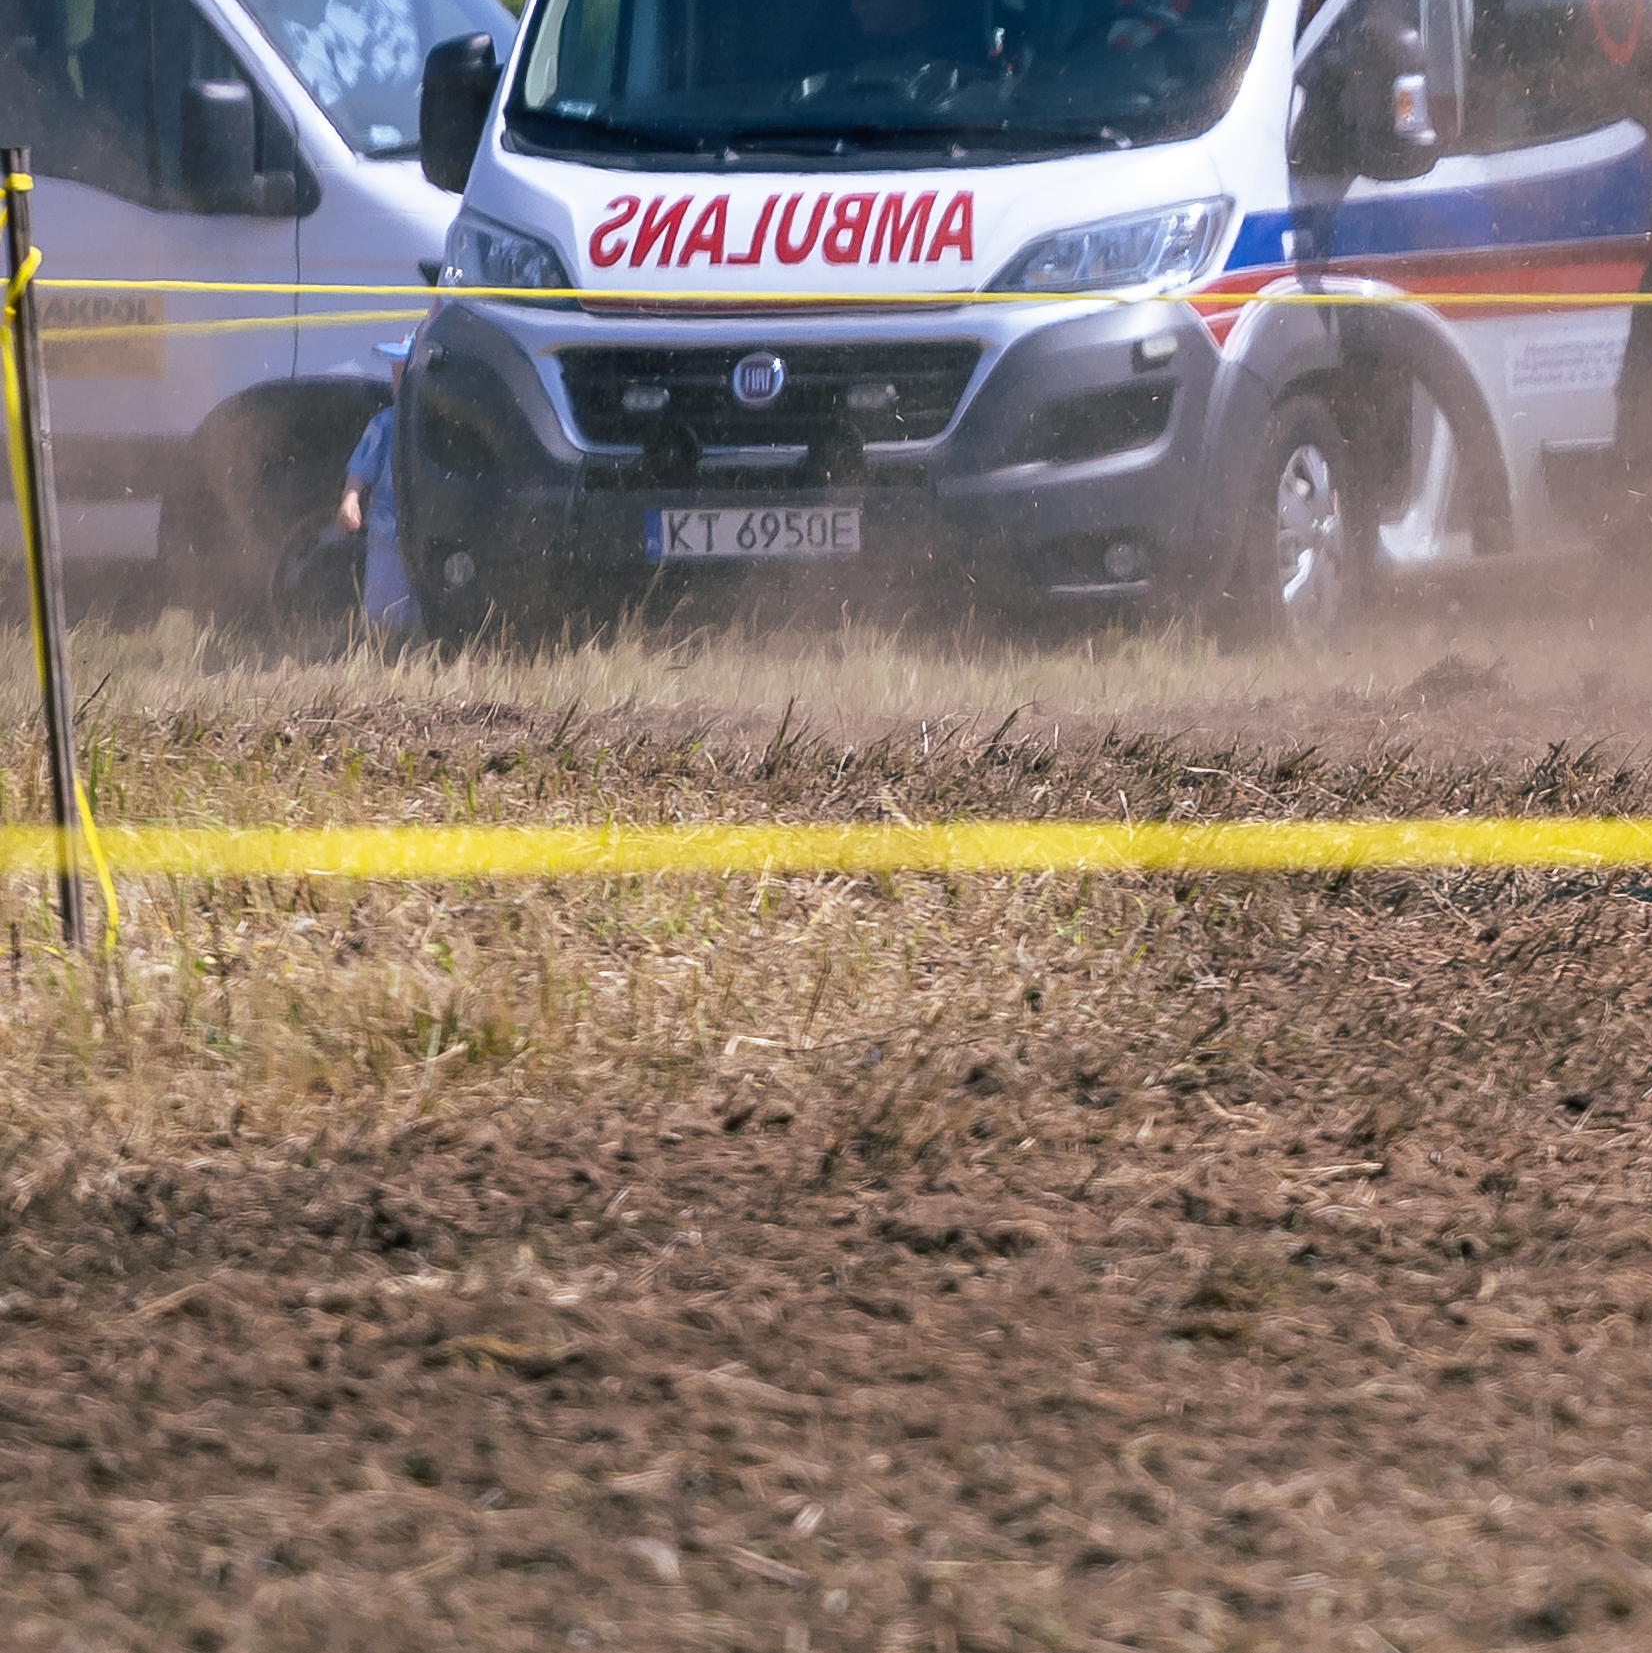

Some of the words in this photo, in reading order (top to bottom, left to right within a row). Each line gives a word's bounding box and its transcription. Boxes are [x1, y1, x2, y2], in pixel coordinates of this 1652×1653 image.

[37, 298, 156, 326] AKPOL
[667, 511, 722, 553] KT
[735, 511, 856, 552] 6950E
